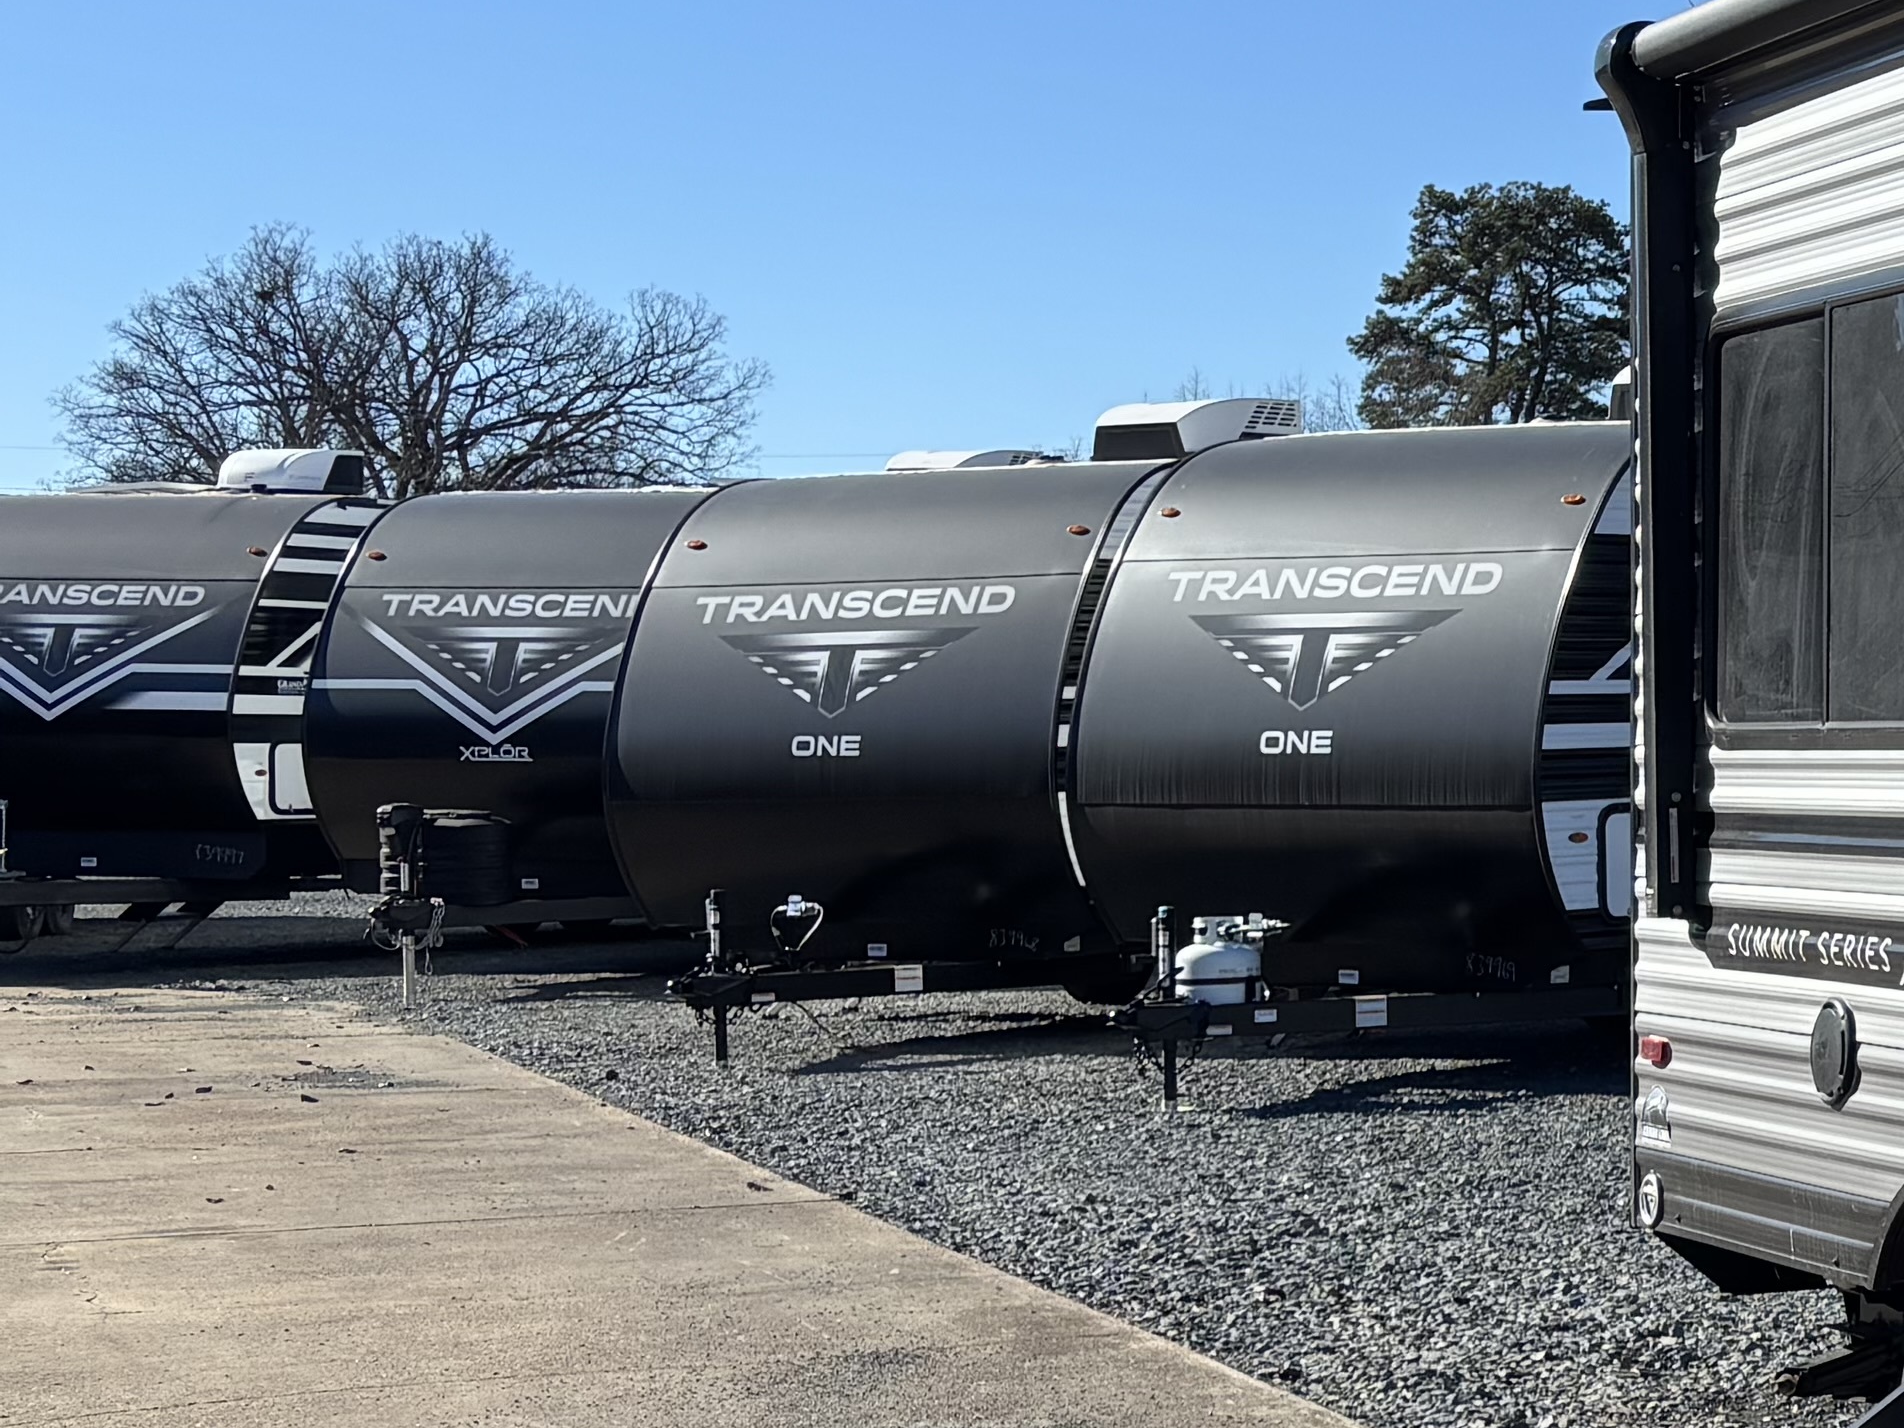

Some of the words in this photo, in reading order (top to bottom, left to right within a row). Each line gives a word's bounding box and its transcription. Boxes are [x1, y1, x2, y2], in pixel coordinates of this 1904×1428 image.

[0, 584, 205, 606] ANSCEND
[1168, 562, 1503, 602] TRANSCEND
[697, 585, 1015, 624] TRANSCEND
[791, 735, 861, 757] ONE
[1260, 730, 1333, 755] ONE
[1728, 923, 1810, 962] SUMMIT
[1817, 931, 1892, 972] SERIES
